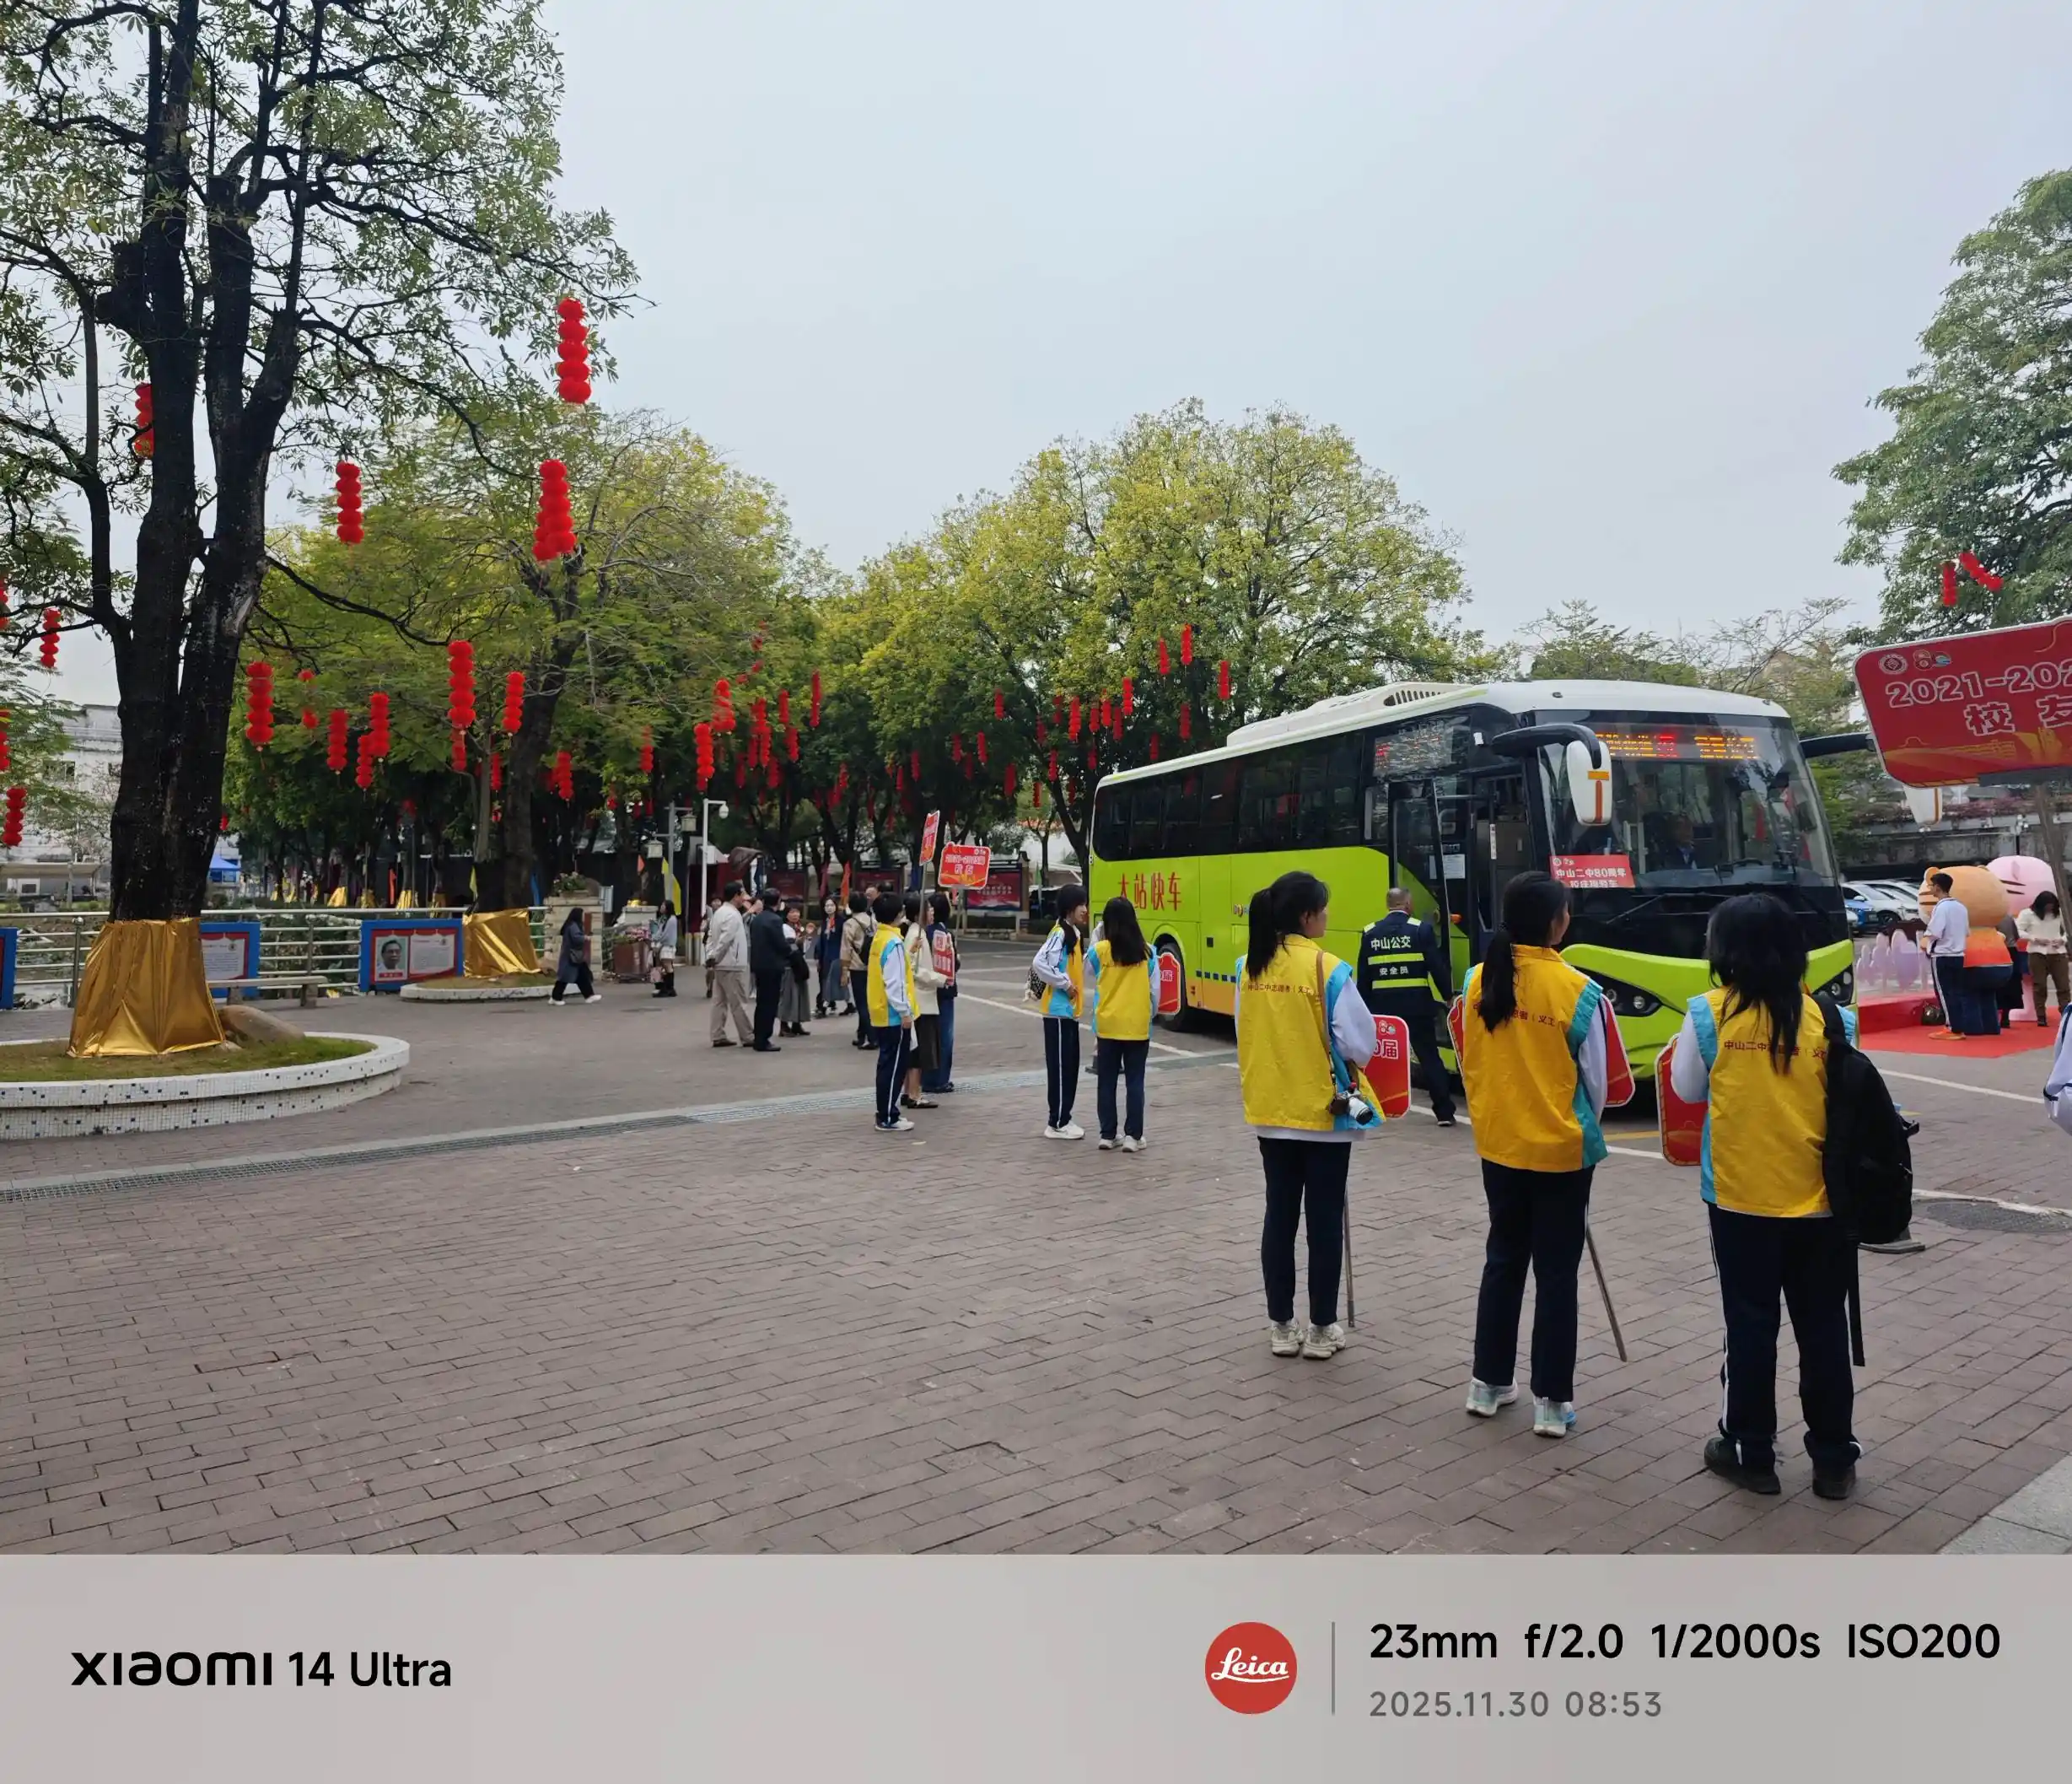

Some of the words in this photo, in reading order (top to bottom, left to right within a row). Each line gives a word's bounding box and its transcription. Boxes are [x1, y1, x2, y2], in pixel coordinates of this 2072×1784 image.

[1557, 867, 1627, 878] 中山二中80周年
[1118, 871, 1181, 911] 大站快车
[1370, 935, 1412, 951] 中山公交
[1379, 966, 1409, 976] 安全员
